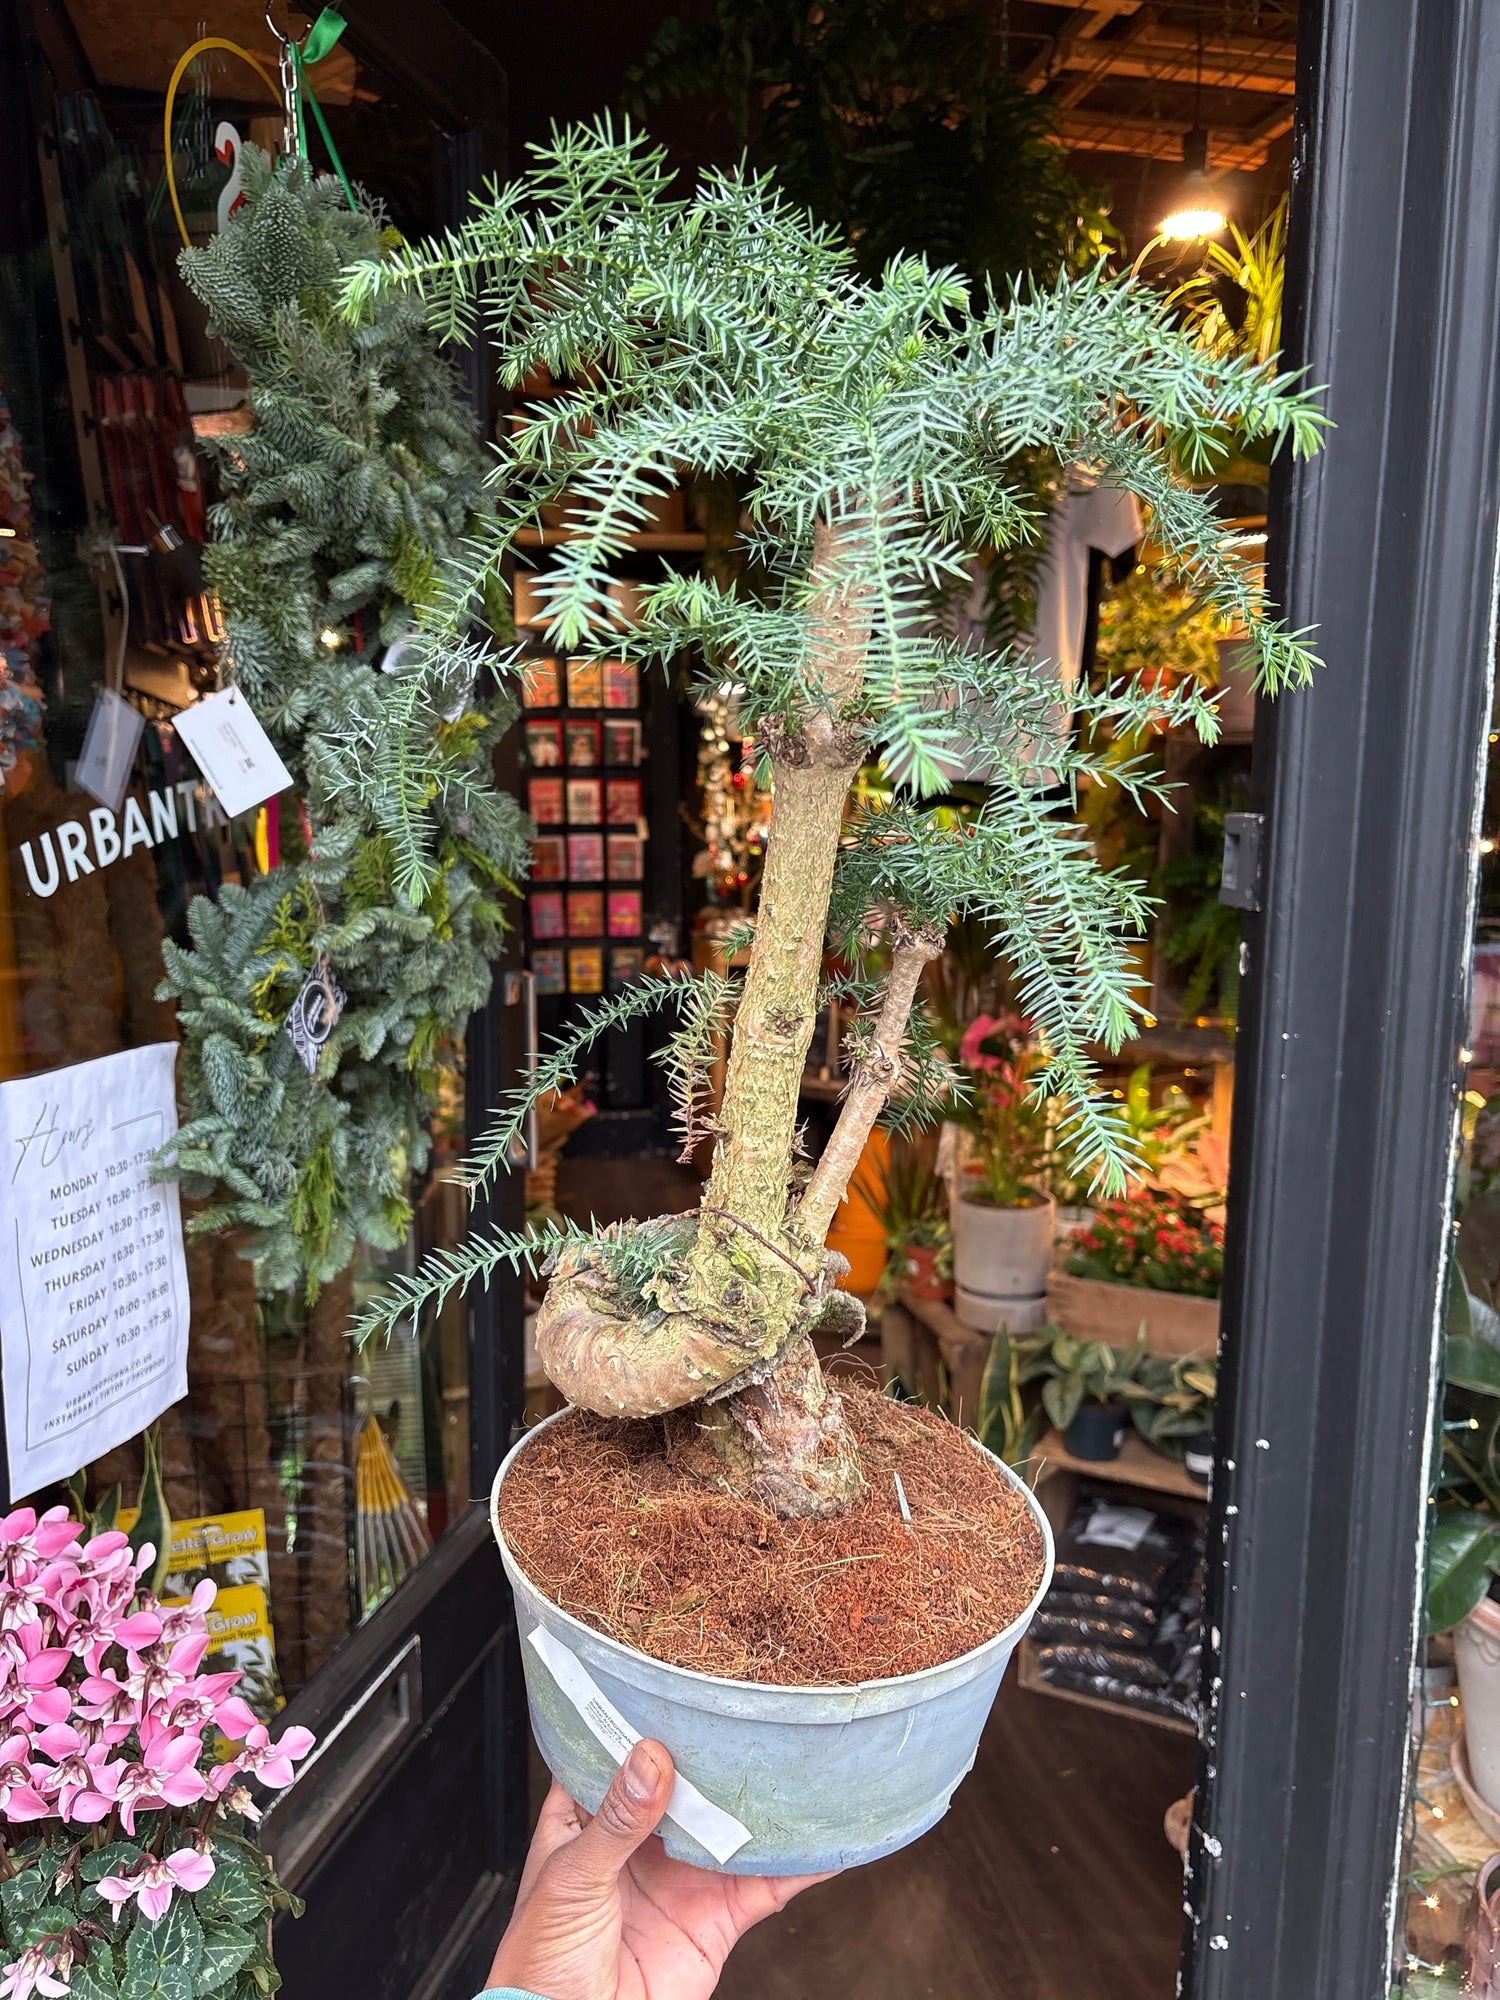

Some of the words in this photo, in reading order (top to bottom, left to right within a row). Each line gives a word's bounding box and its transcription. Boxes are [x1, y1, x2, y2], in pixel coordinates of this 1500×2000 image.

[12, 1101, 95, 1185] Hours
[50, 1171, 99, 1200] MONDAY
[104, 1158, 129, 1178] 10:30
[51, 1202, 101, 1231] TUESDAY
[107, 1186, 131, 1207] 10:30
[30, 1229, 104, 1268] WEDNESDAY
[110, 1214, 133, 1236] 10:30
[139, 1201, 161, 1220] 17:30
[44, 1258, 106, 1294] THURSDAY
[112, 1243, 135, 1264] 10:30
[141, 1228, 165, 1247] 17:30
[52, 1315, 109, 1355] SATURDAY
[114, 1299, 140, 1320] 10:00
[147, 1281, 170, 1302] 18:00
[69, 1287, 107, 1316] FRIDAY
[112, 1270, 137, 1292] 10:30
[144, 1254, 168, 1275] 17:30
[66, 1343, 109, 1377] SUNDAY
[115, 1325, 141, 1348] 10:30
[148, 1307, 173, 1328] 17:30
[44, 1399, 94, 1431] INSTAGRAM
[100, 1381, 124, 1399] TIKTOK
[132, 1357, 165, 1381] FACEBOOK
